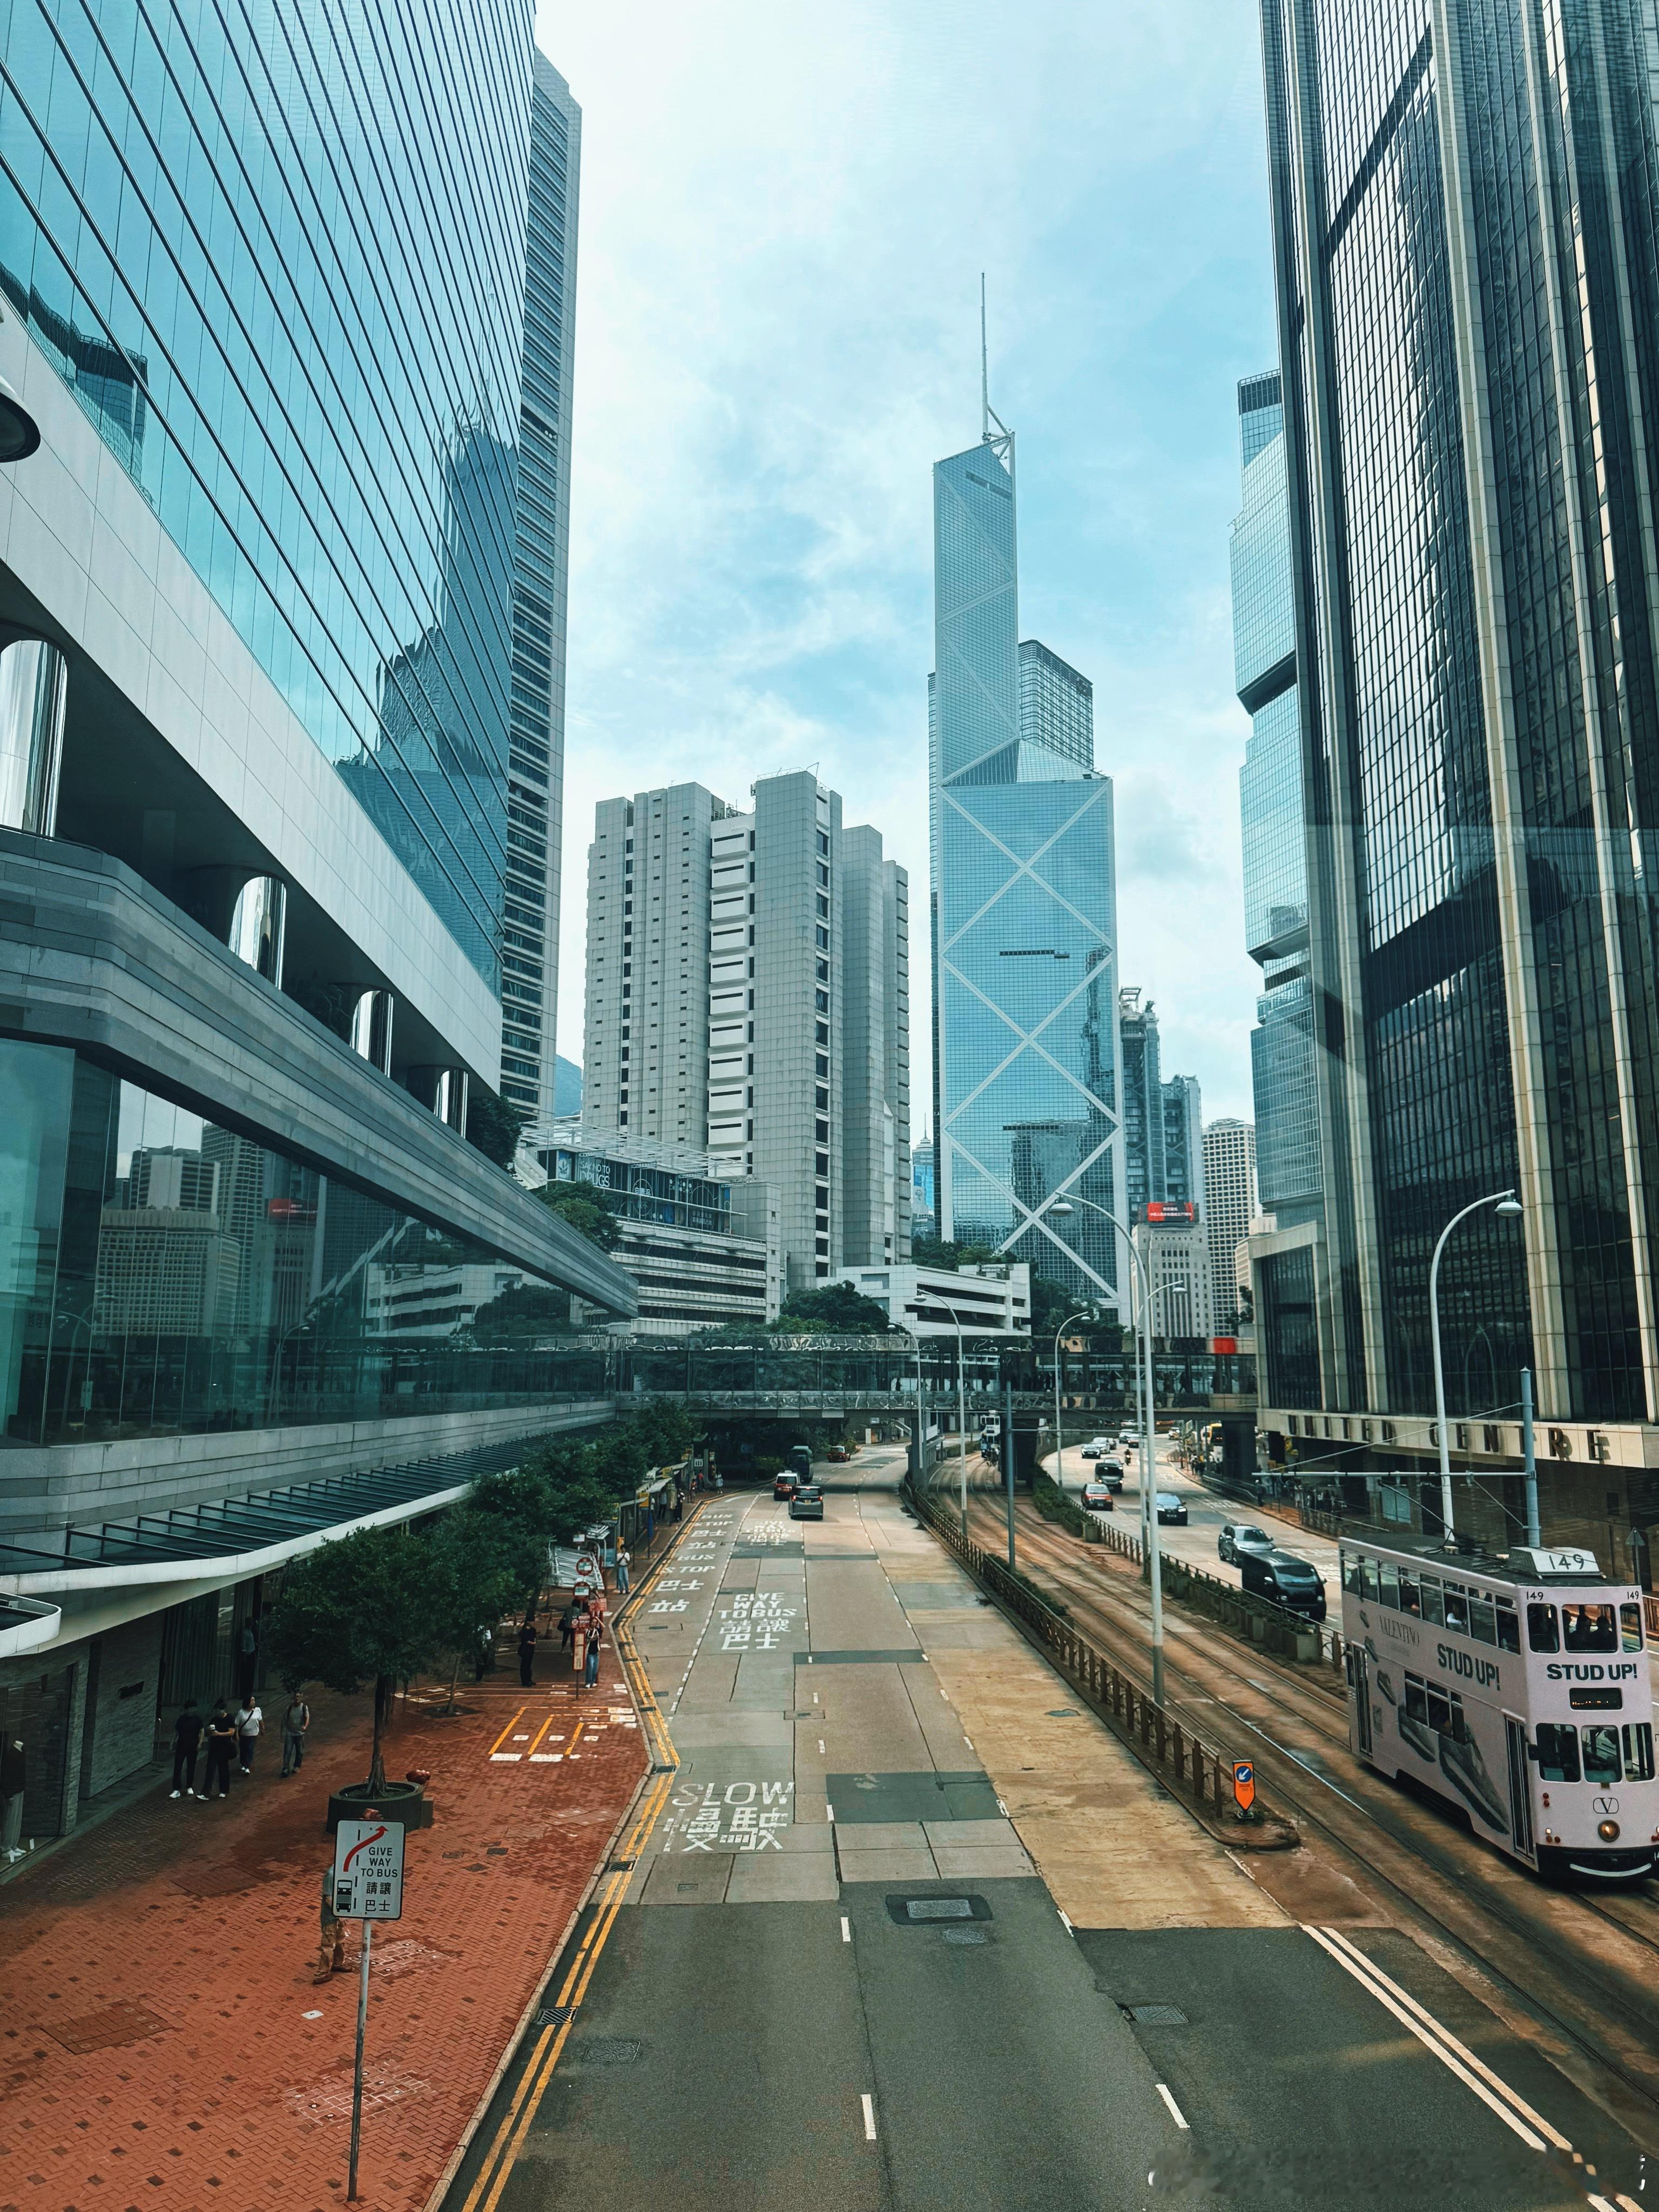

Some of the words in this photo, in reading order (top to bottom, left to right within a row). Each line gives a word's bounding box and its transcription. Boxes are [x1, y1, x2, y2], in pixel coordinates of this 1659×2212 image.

[602, 1165, 610, 1174] TO
[1288, 1414, 1395, 1442] UNITED
[1549, 1554, 1584, 1570] 149
[655, 1580, 704, 1591] 巴士
[735, 1592, 785, 1601] GIVE
[1526, 1591, 1543, 1601] 149
[1627, 1591, 1639, 1600] 149
[649, 1599, 690, 1613] 站
[733, 1601, 781, 1609] WAY
[718, 1610, 747, 1618] TO
[751, 1608, 797, 1618] BUS
[719, 1618, 791, 1634] 請讓
[721, 1633, 780, 1650] 巴士
[1437, 1643, 1473, 1678] STUD
[1475, 1658, 1500, 1691] UP!
[1547, 1663, 1604, 1681] STUD
[1608, 1663, 1637, 1680] UP!
[672, 1782, 794, 1806] SLOW
[1599, 1797, 1614, 1813] V
[663, 1807, 788, 1852] 慢駛
[368, 1846, 393, 1856] GIVE
[369, 1858, 391, 1866] WAY
[361, 1868, 374, 1877] TO
[377, 1869, 398, 1878] BUS
[366, 1881, 391, 1894] 請讓
[365, 1899, 390, 1912] 巴士
